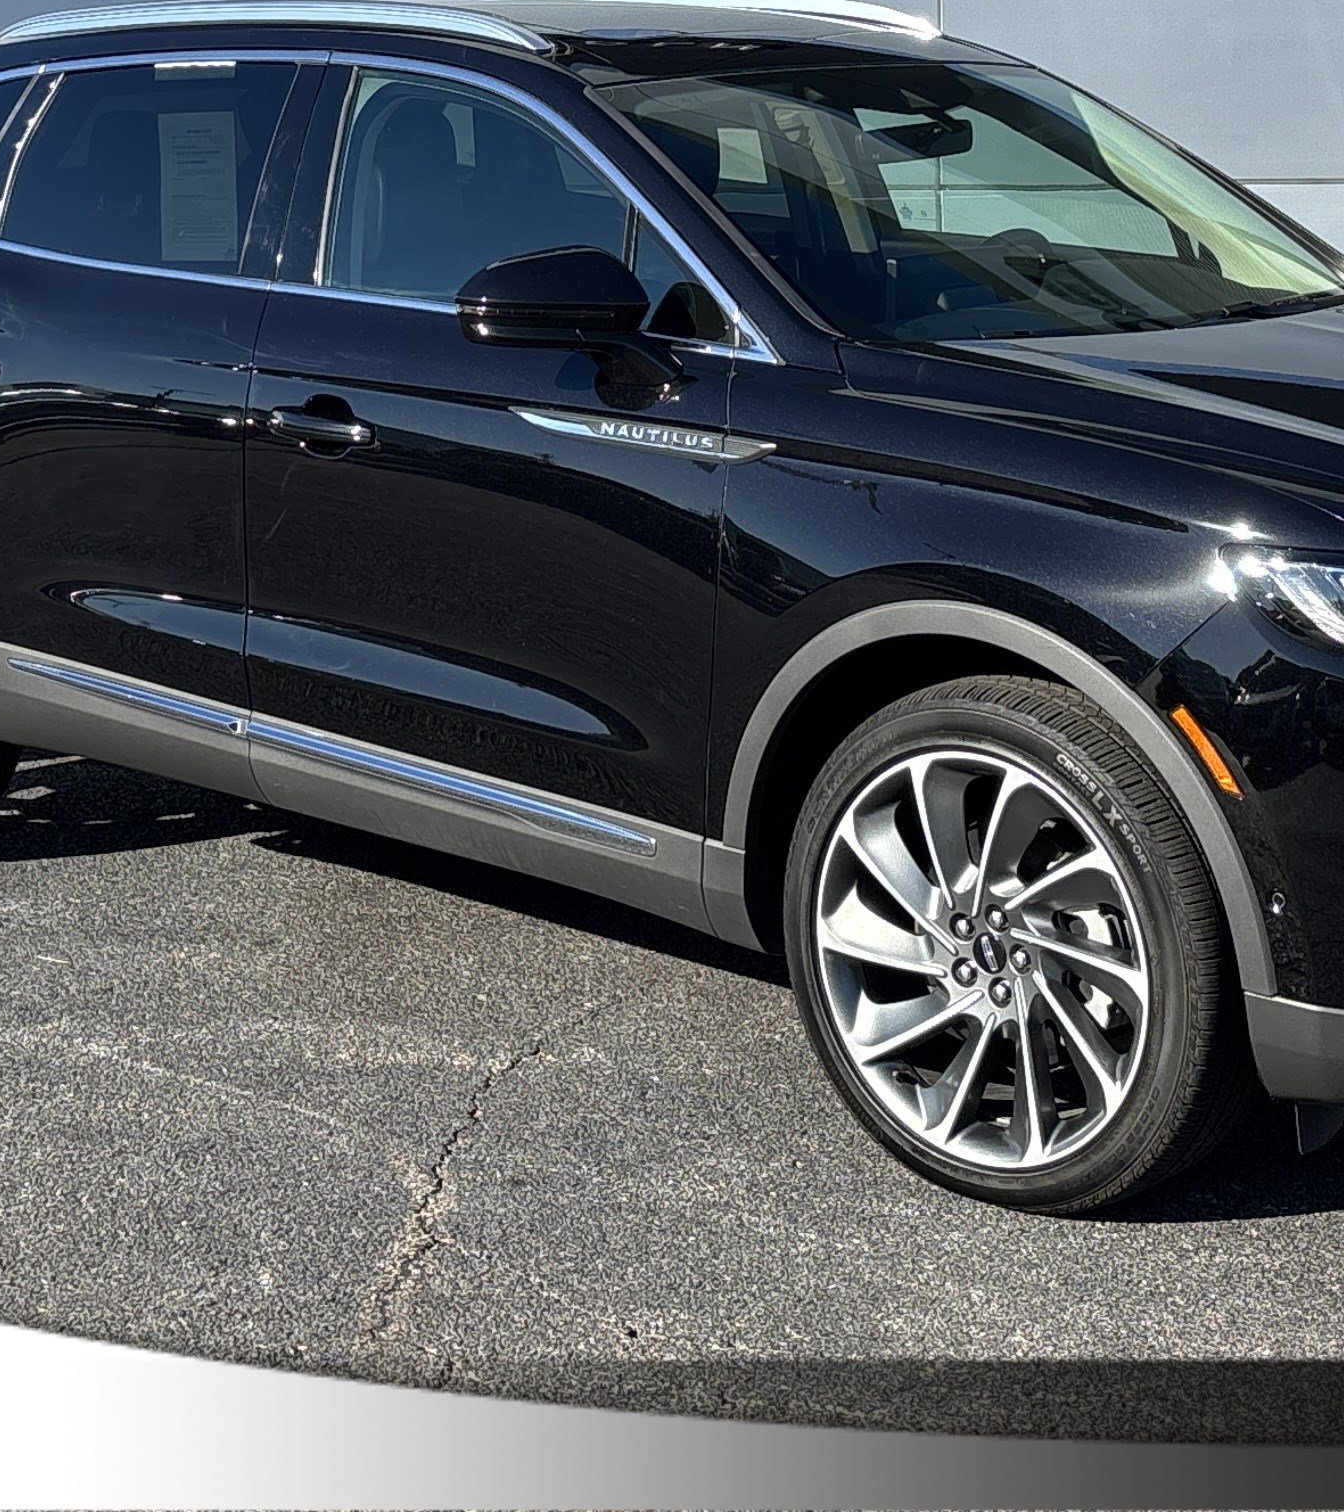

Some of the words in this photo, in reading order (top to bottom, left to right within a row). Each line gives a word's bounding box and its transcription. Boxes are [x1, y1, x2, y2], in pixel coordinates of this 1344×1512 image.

[600, 422, 714, 449] NAUTILUS
[1056, 754, 1097, 793] CROSS
[1119, 823, 1152, 873] SPORT
